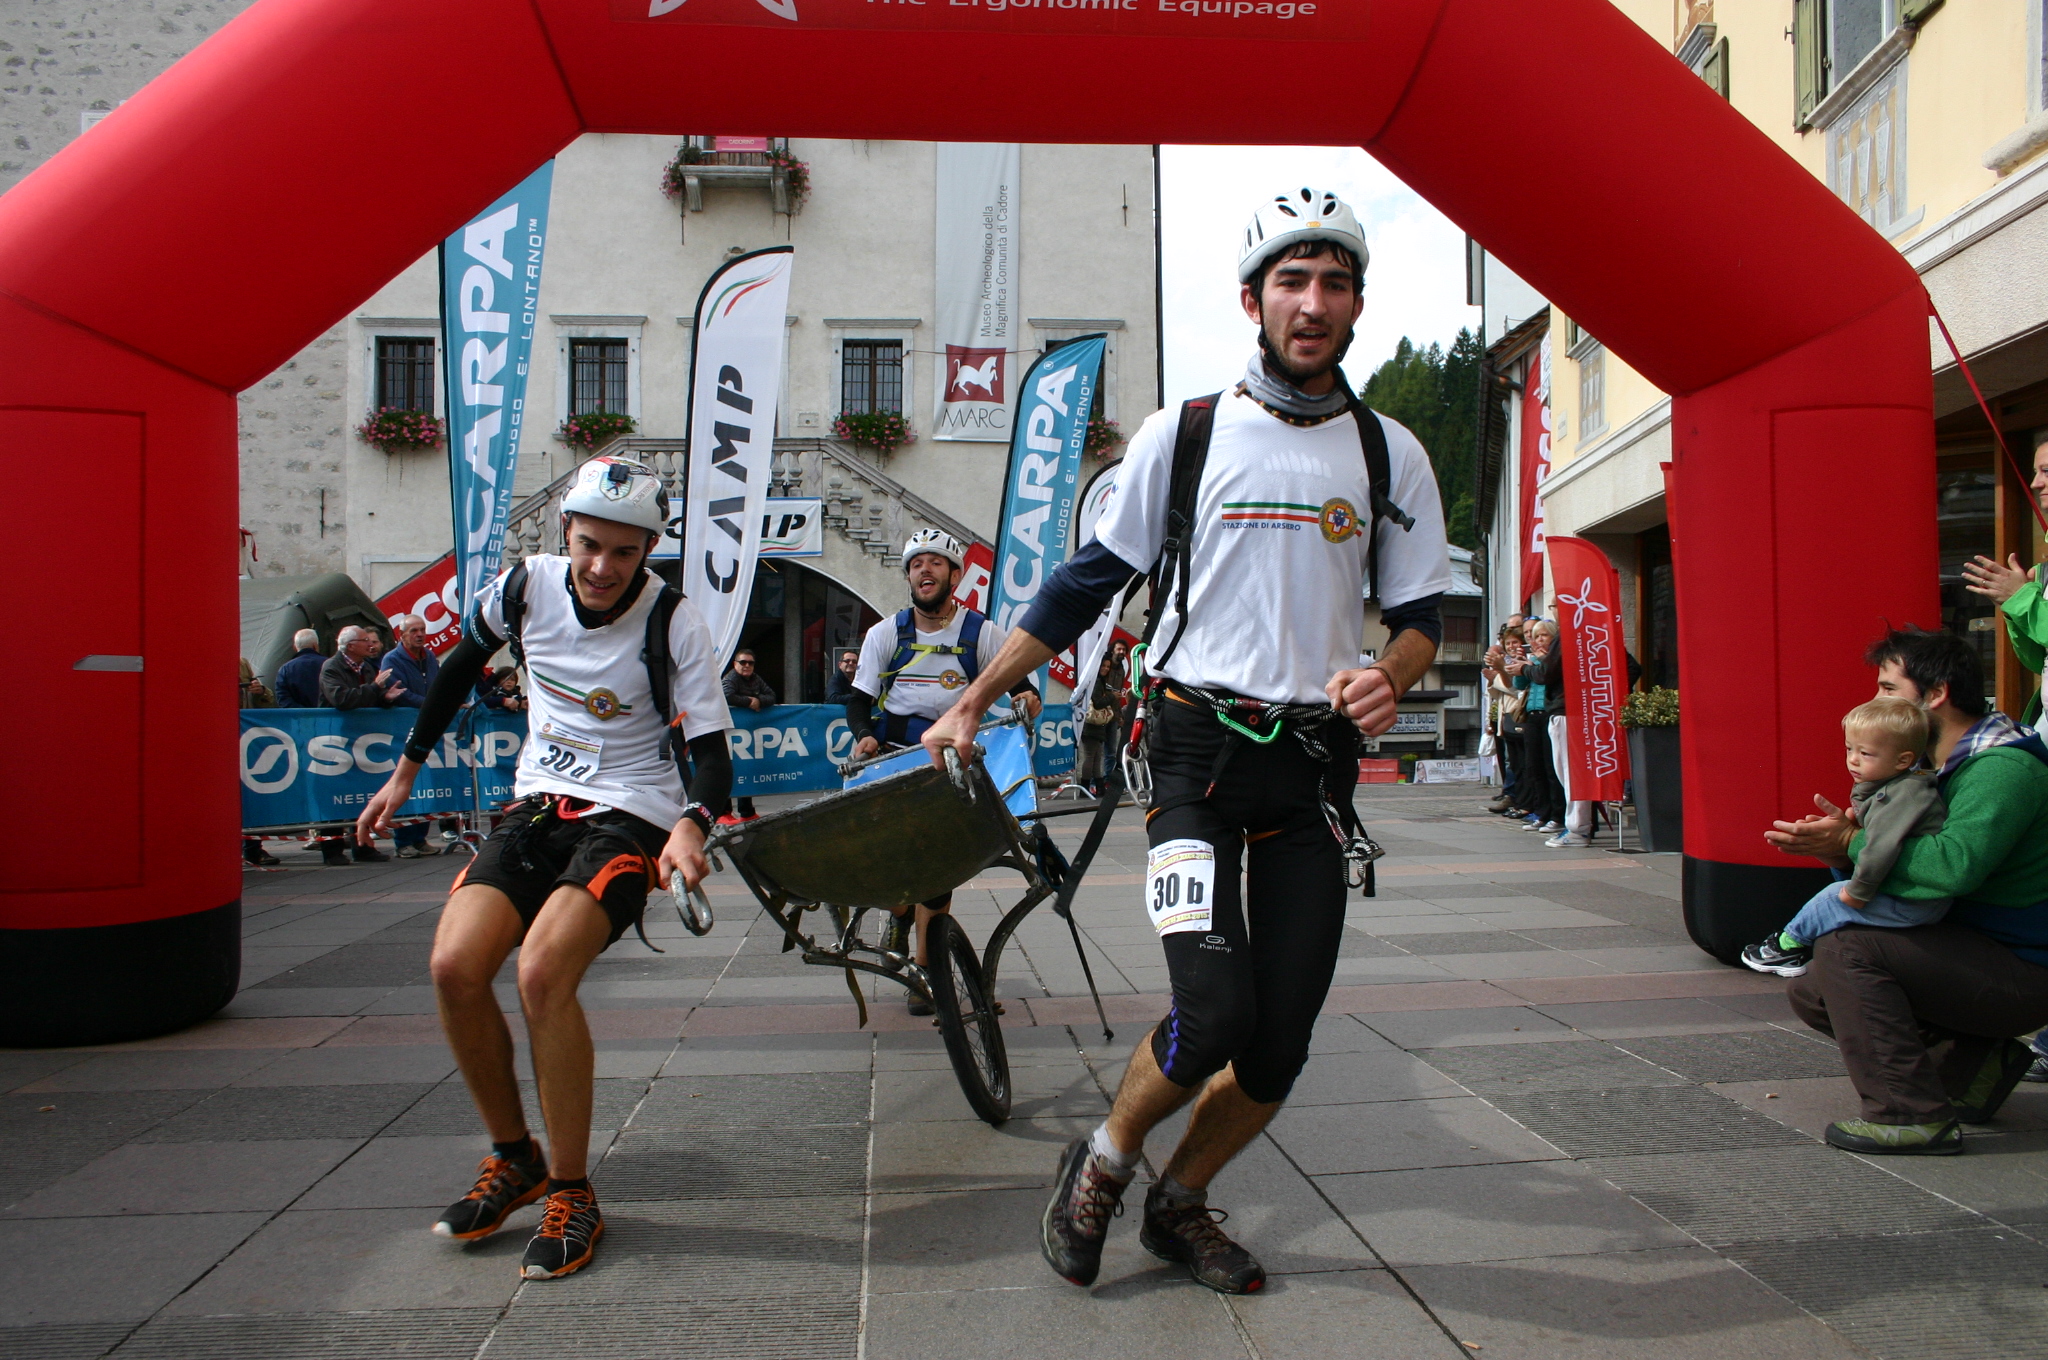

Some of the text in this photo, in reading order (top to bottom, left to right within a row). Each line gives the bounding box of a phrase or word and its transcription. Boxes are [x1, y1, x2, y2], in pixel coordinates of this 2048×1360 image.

[1158, 0, 1317, 19] Equipage
[981, 205, 994, 337] Museo Archeologico della
[995, 184, 1008, 338] Magnifica Comunità di Cadore
[941, 408, 1005, 429] MARC
[705, 364, 753, 594] CAMP
[483, 489, 509, 586] NESSUN
[1055, 498, 1070, 549] LUOGO
[1222, 522, 1259, 530] STAZIONE
[1271, 522, 1301, 531] ARSIERO
[539, 744, 576, 772] 30
[485, 785, 515, 796] LONT
[1153, 872, 1204, 912] 30 b
[1200, 943, 1232, 953] Kalenji
